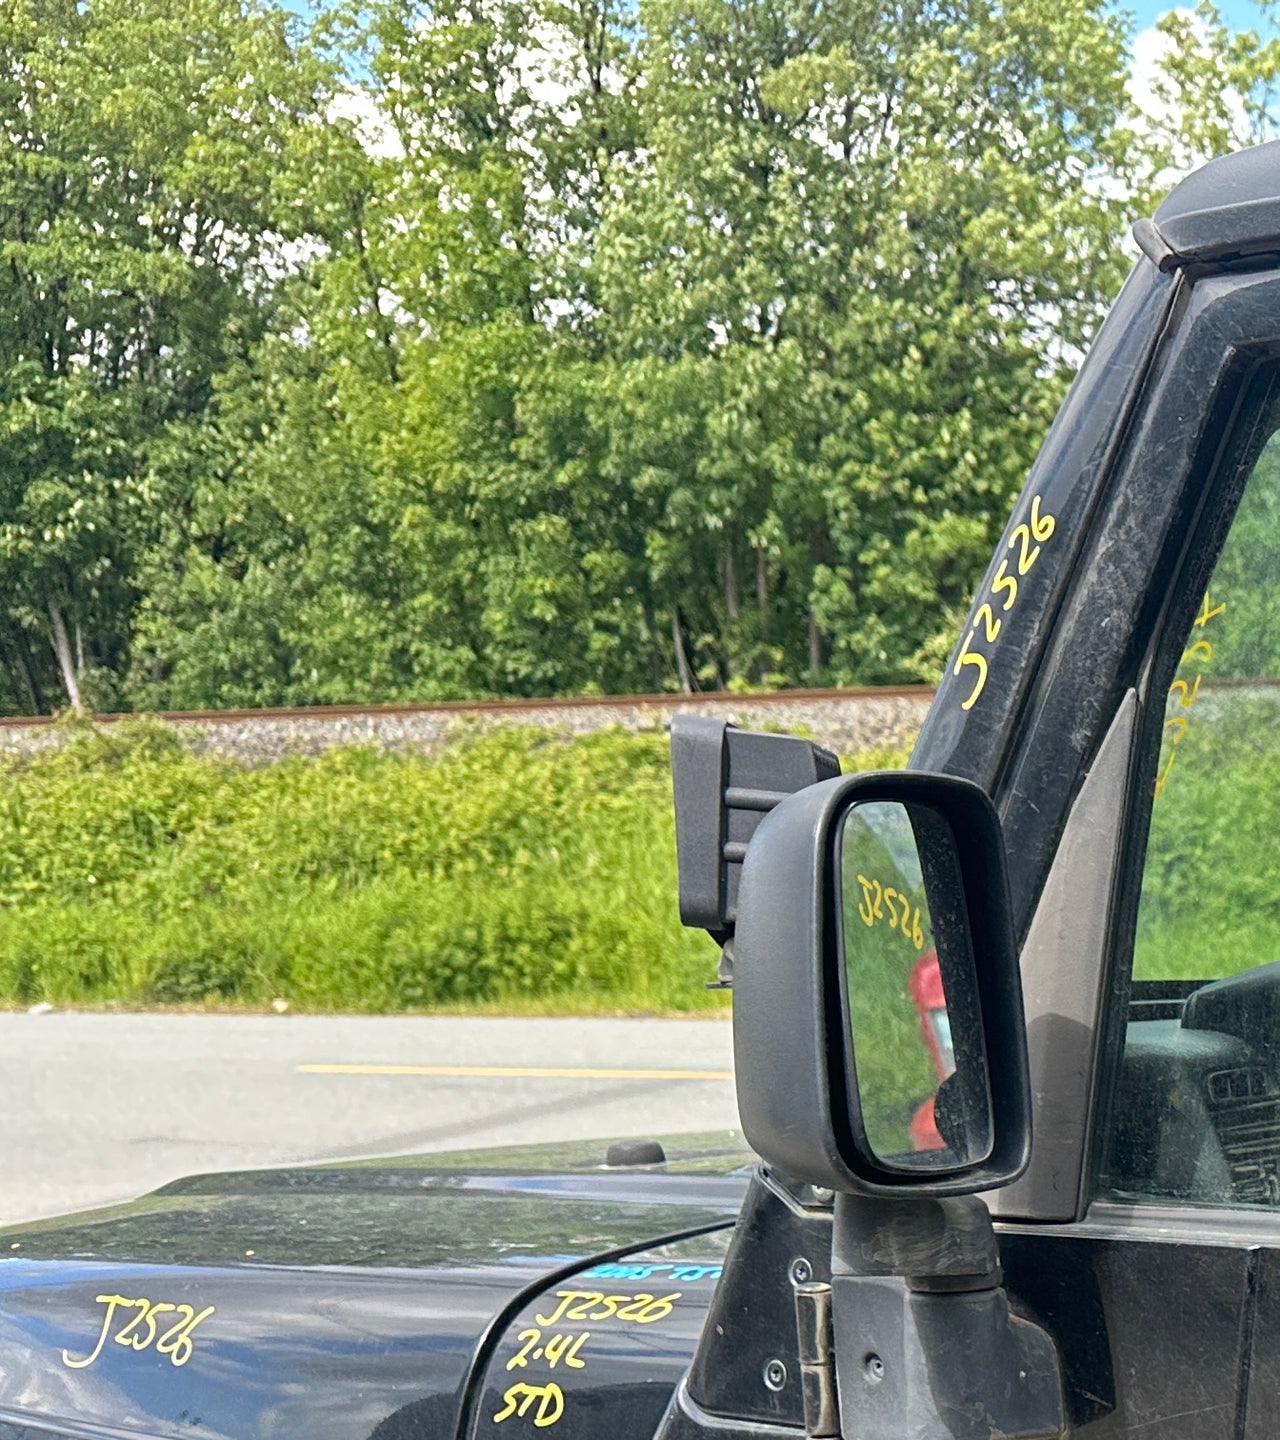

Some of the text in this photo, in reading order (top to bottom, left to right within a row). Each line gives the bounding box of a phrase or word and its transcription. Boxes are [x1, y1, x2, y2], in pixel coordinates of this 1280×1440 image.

[954, 496, 1056, 711] J2526
[856, 873, 925, 951] J2526
[62, 1294, 214, 1369] J2526
[537, 1291, 682, 1323] J2526
[494, 1383, 564, 1427] STD
